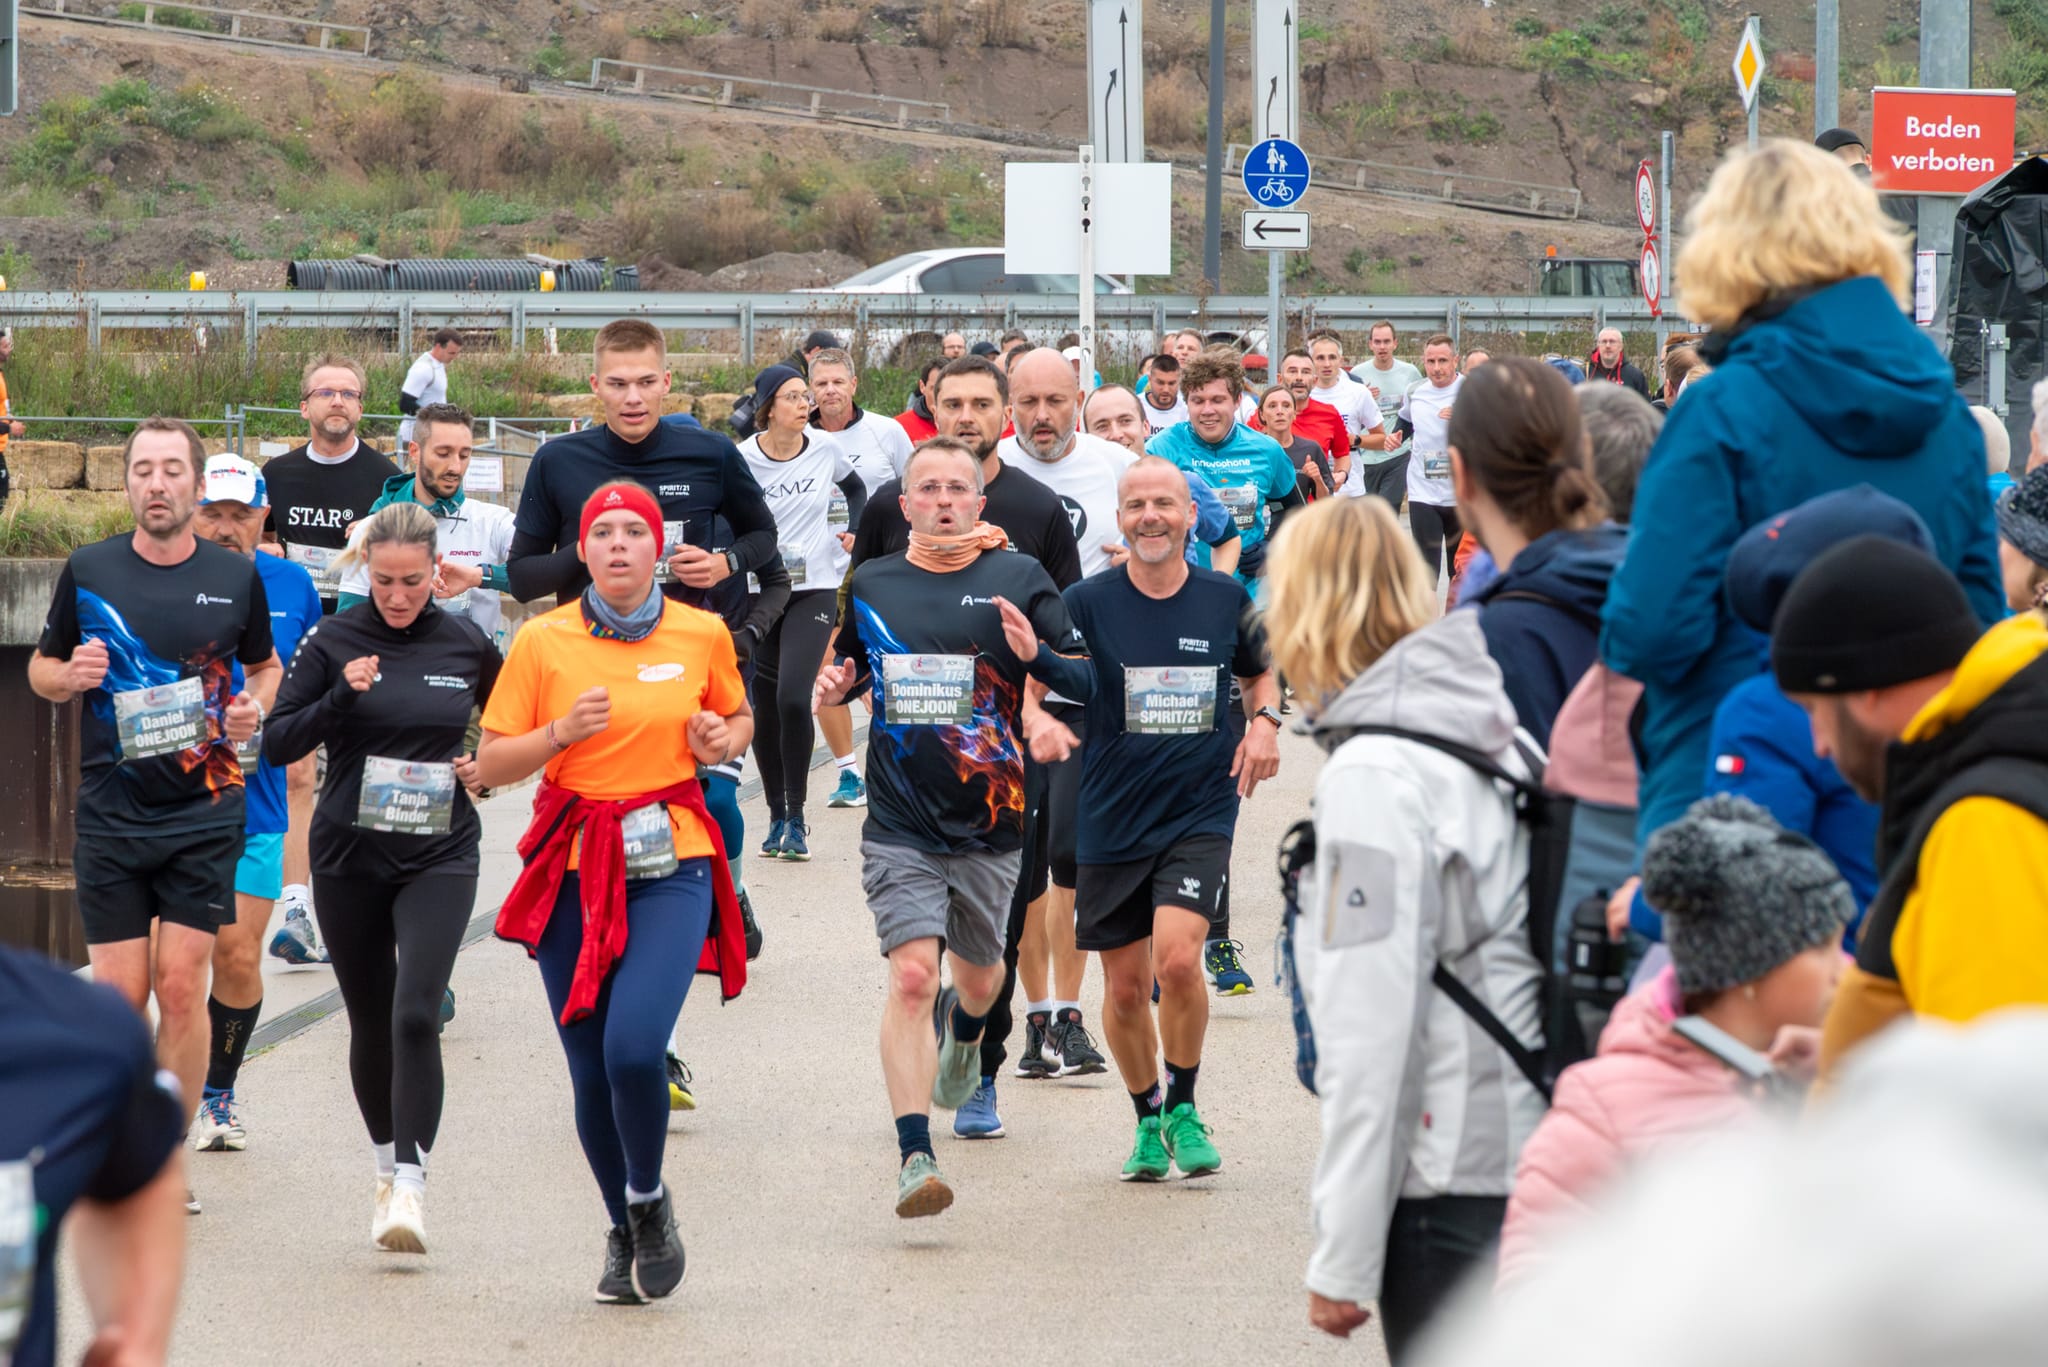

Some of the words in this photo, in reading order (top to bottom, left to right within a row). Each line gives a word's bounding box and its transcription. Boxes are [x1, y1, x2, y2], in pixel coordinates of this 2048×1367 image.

[1906, 115, 1981, 138] Baden
[1891, 147, 1995, 172] verboten
[762, 478, 816, 499] KMZ
[891, 683, 963, 698] Dominikus
[896, 700, 958, 715] ONEJOON
[1146, 694, 1199, 708] Michael
[141, 709, 186, 731] Daniel
[1140, 711, 1203, 724] SPIRIT/21
[134, 722, 198, 749] ONEJOON
[392, 789, 429, 809] Tanja
[384, 806, 431, 824] Binder
